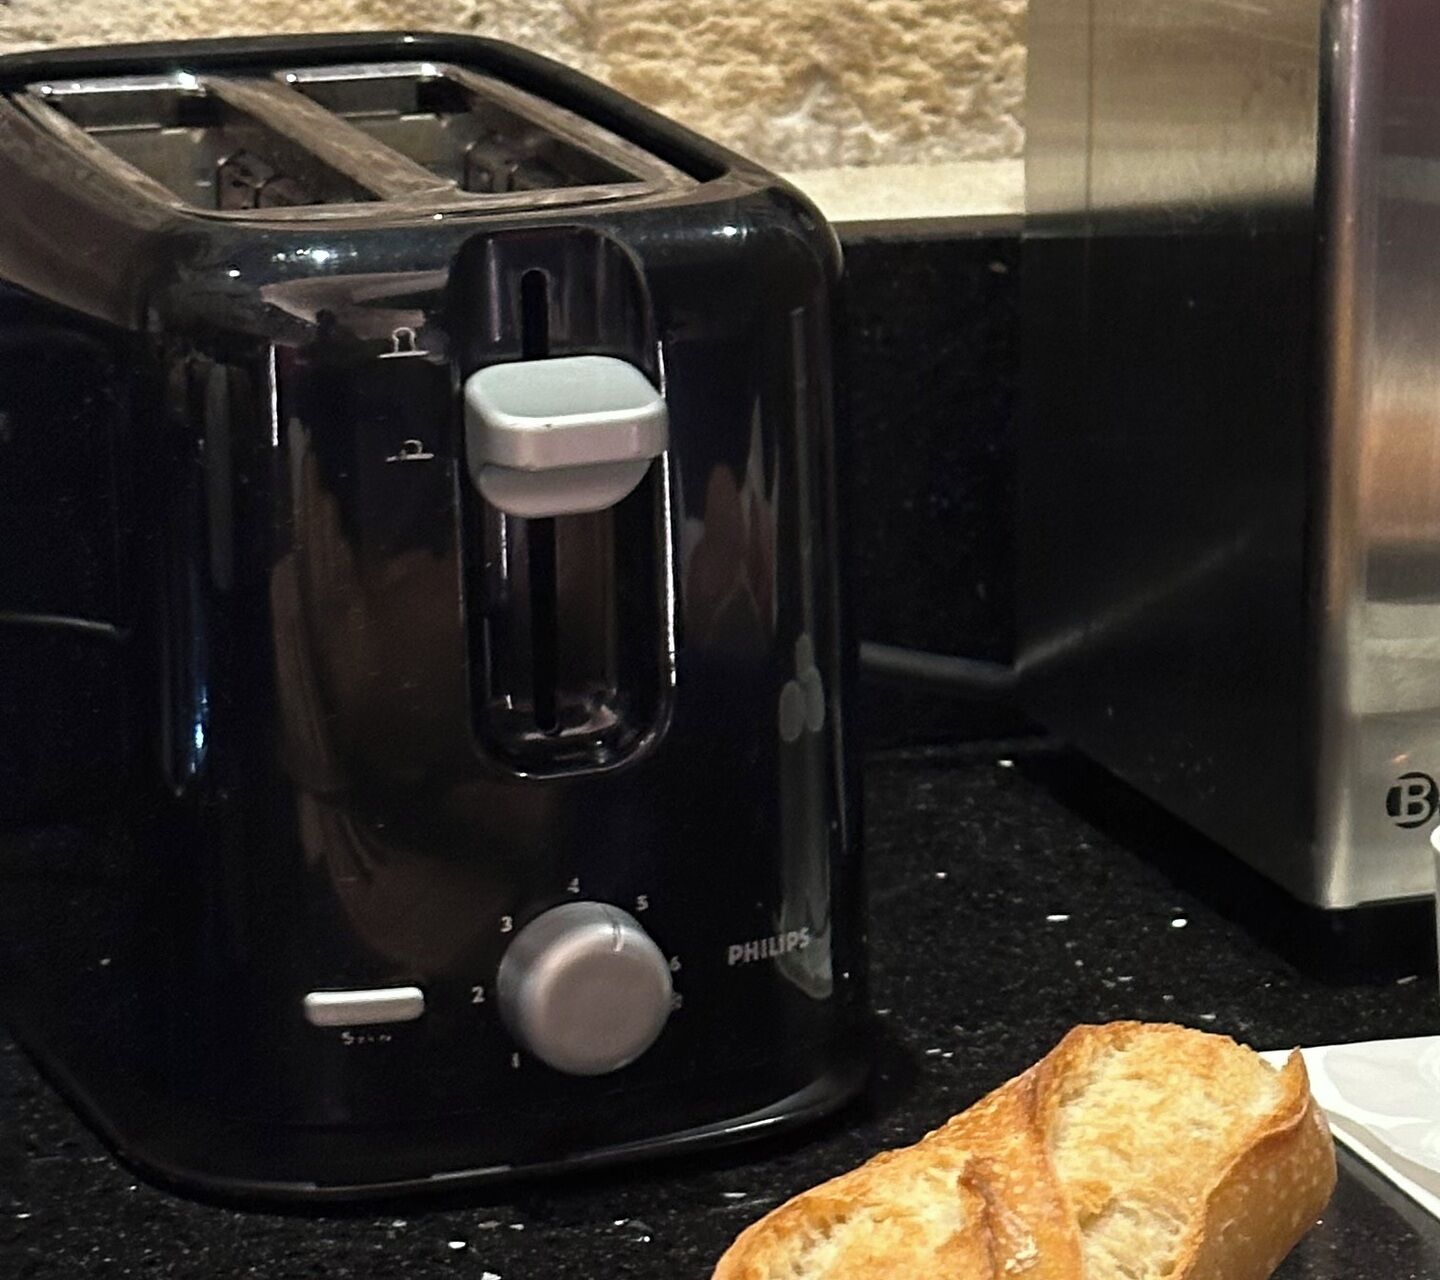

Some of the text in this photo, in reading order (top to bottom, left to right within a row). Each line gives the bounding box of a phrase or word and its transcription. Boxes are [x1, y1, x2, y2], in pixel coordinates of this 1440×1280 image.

[567, 877, 580, 894] 4
[500, 916, 513, 933] 3
[728, 927, 809, 966] PHILIPS
[471, 986, 485, 1004] 2
